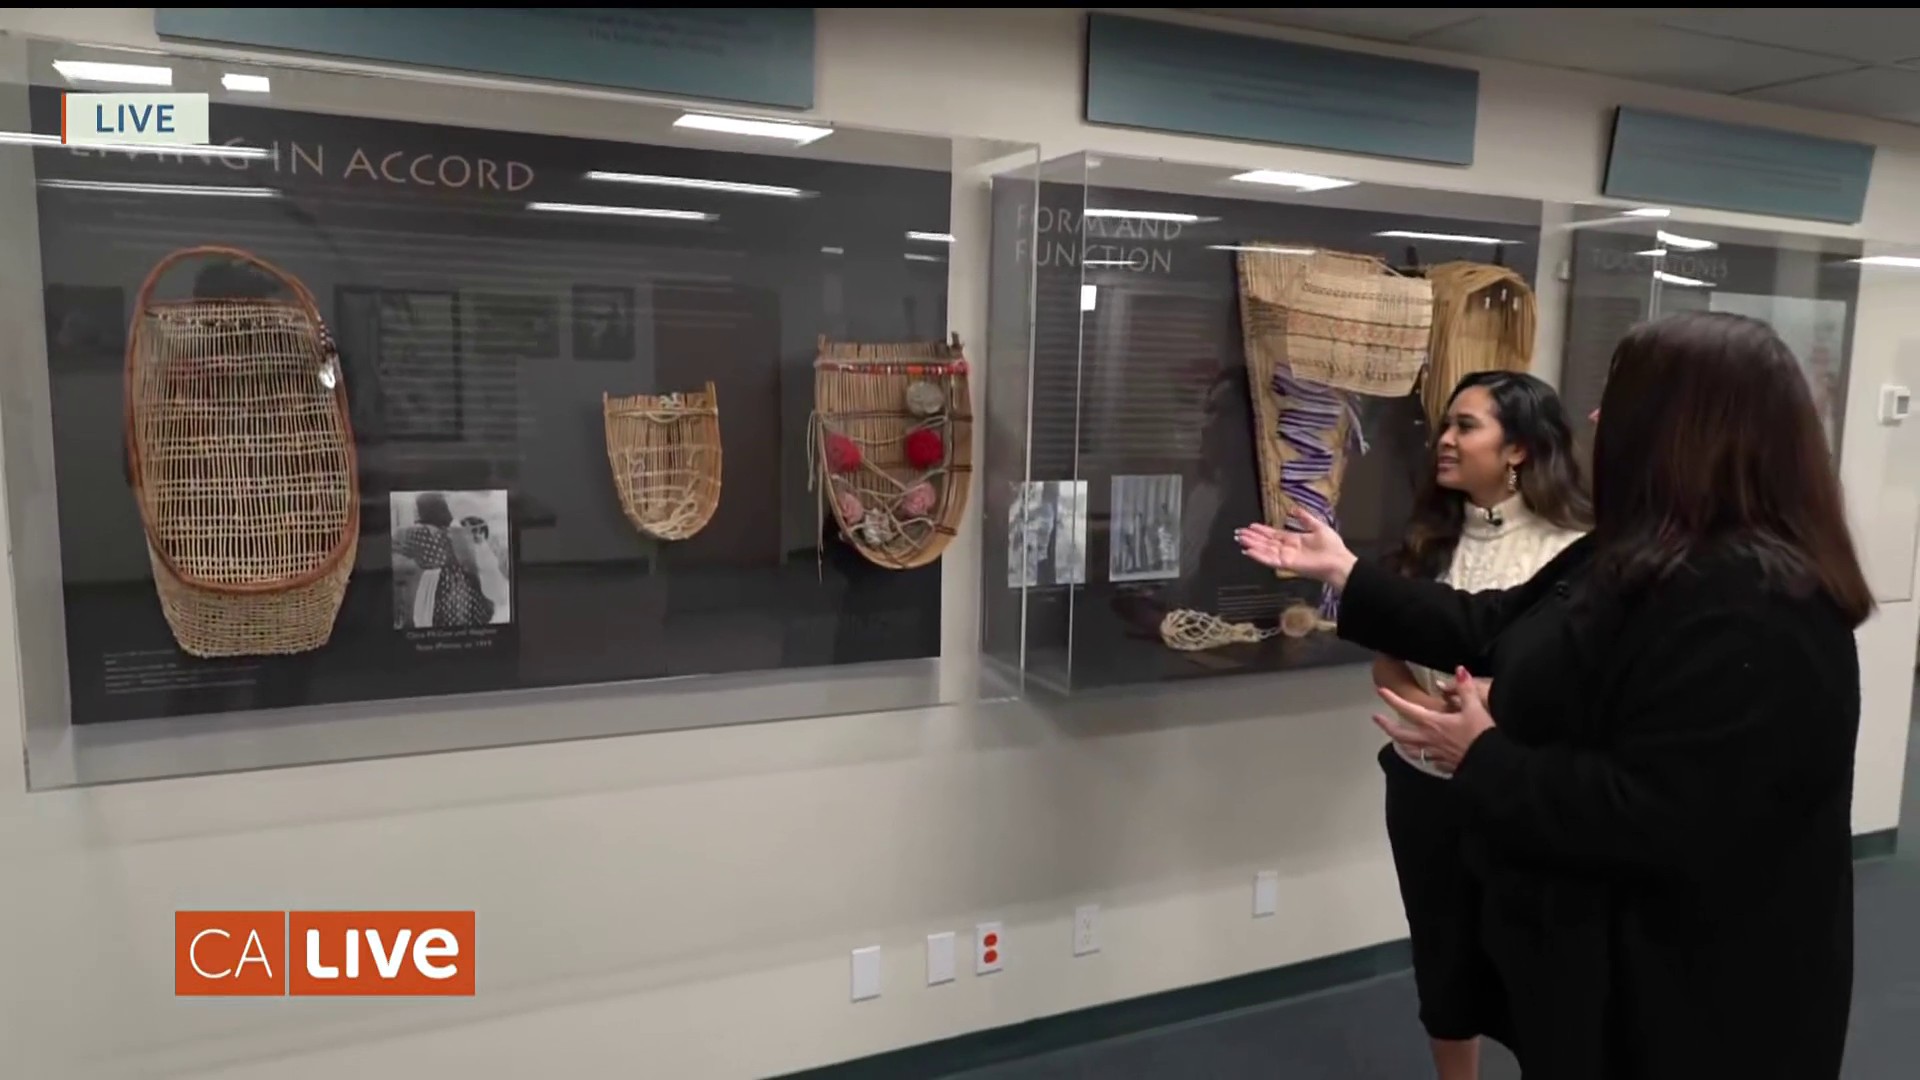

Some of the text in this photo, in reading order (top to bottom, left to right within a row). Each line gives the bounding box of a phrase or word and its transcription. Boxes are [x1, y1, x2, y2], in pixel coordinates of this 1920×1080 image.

[273, 140, 323, 177] IN
[344, 148, 535, 192] ACCORD
[1016, 204, 1183, 241] FORM AND
[1015, 239, 1172, 273] FUNCTION
